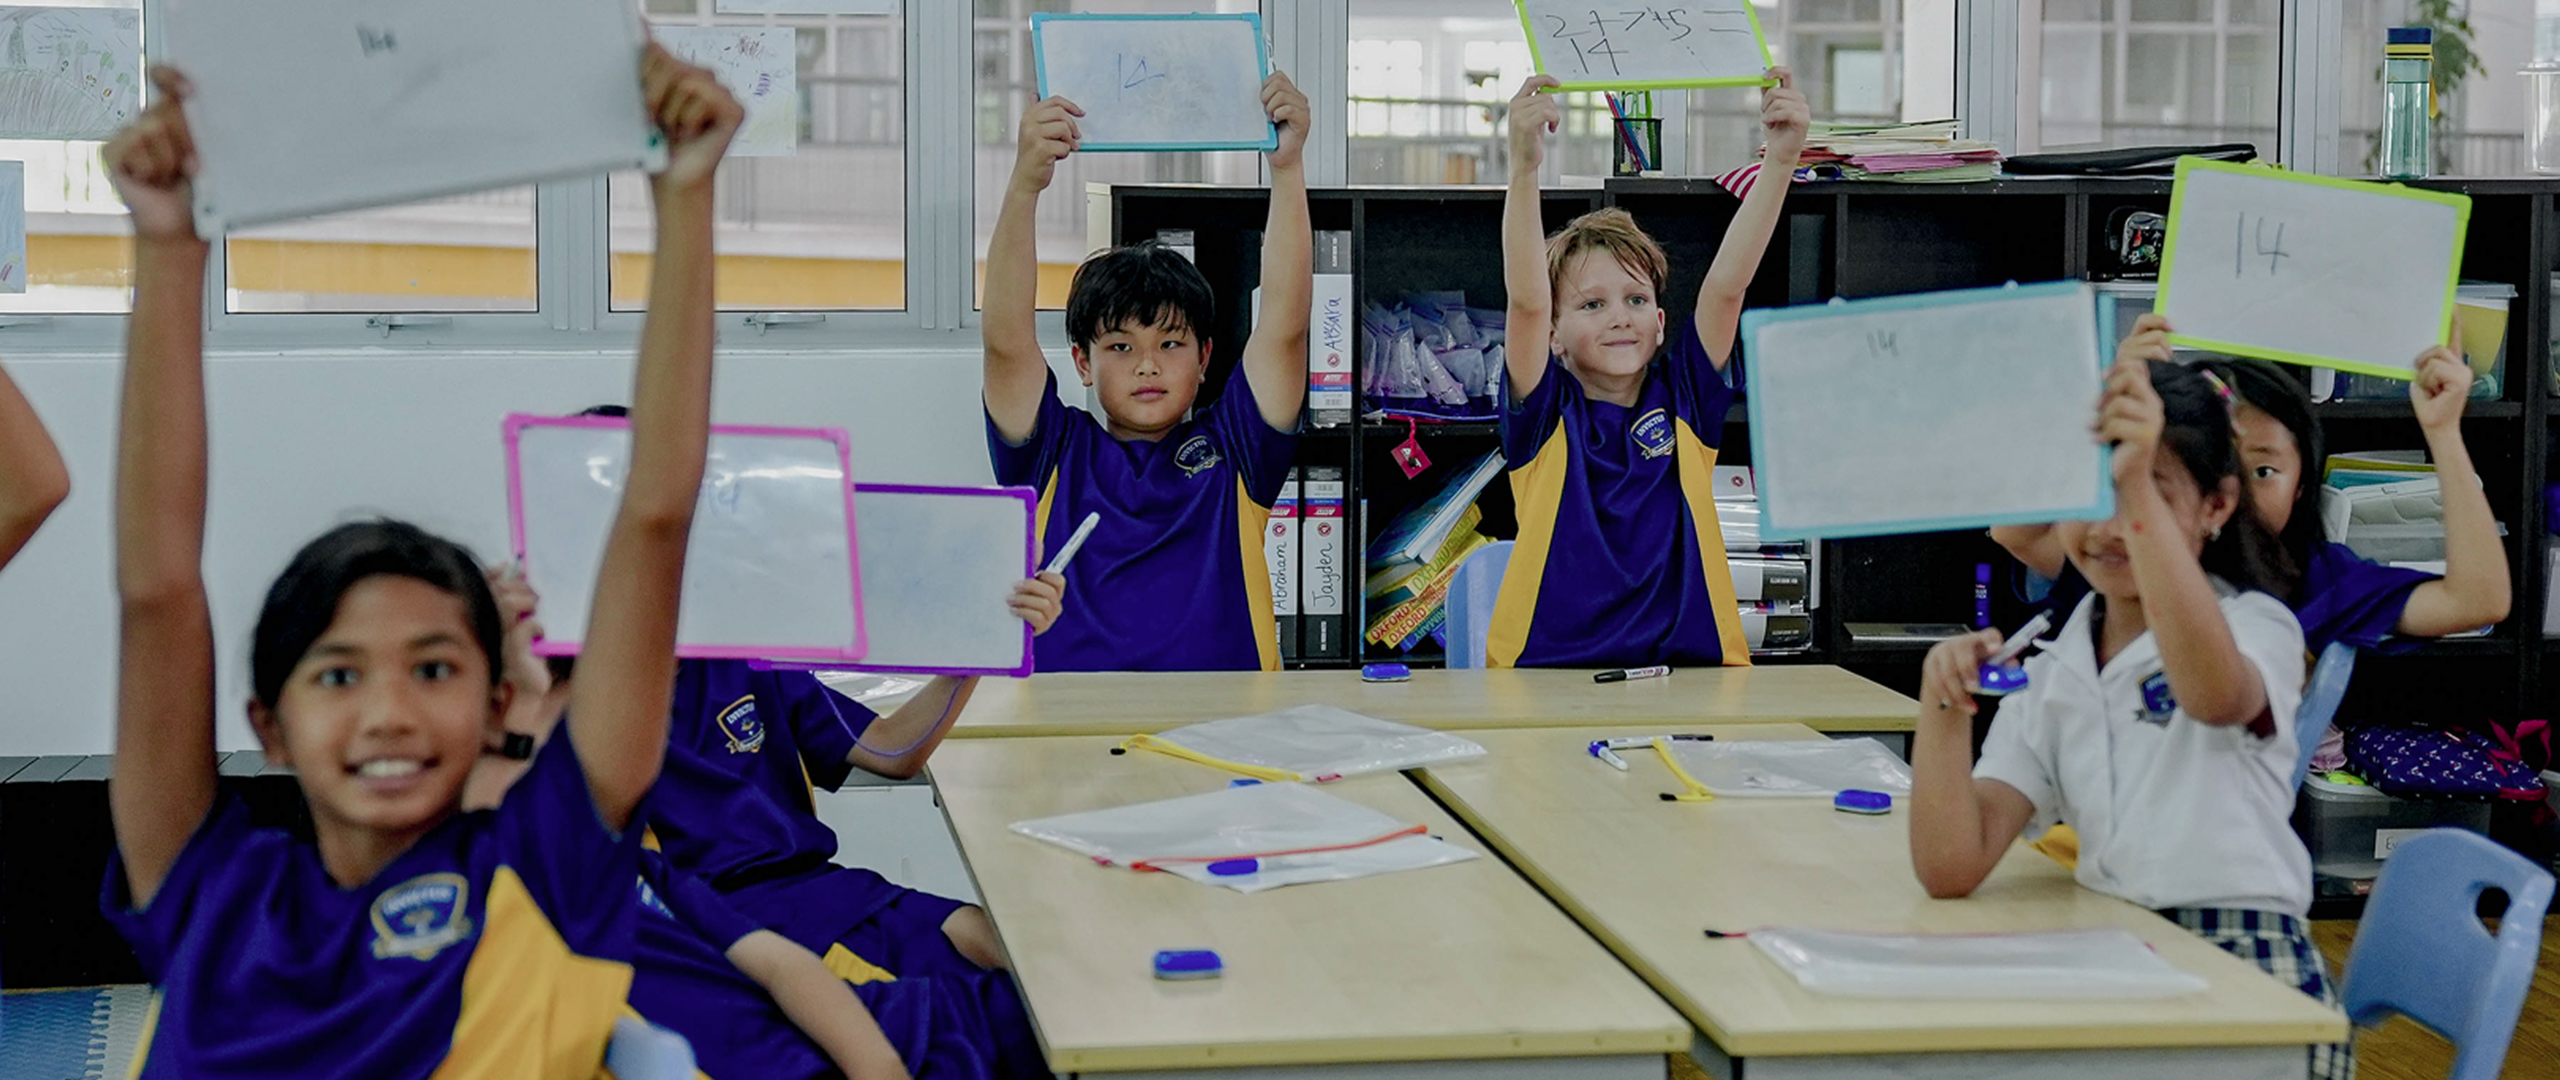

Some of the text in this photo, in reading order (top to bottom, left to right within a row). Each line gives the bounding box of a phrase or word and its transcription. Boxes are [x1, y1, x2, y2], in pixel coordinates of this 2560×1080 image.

[1117, 52, 1166, 101] 14
[1571, 37, 1630, 76] 14
[2235, 210, 2290, 279] 14
[1270, 541, 1288, 610] Abraham
[1311, 542, 1341, 608] Jayden
[1370, 605, 1411, 641] OXFORD
[1388, 607, 1427, 644] OXFORD
[1413, 608, 1446, 642] RIMARY
